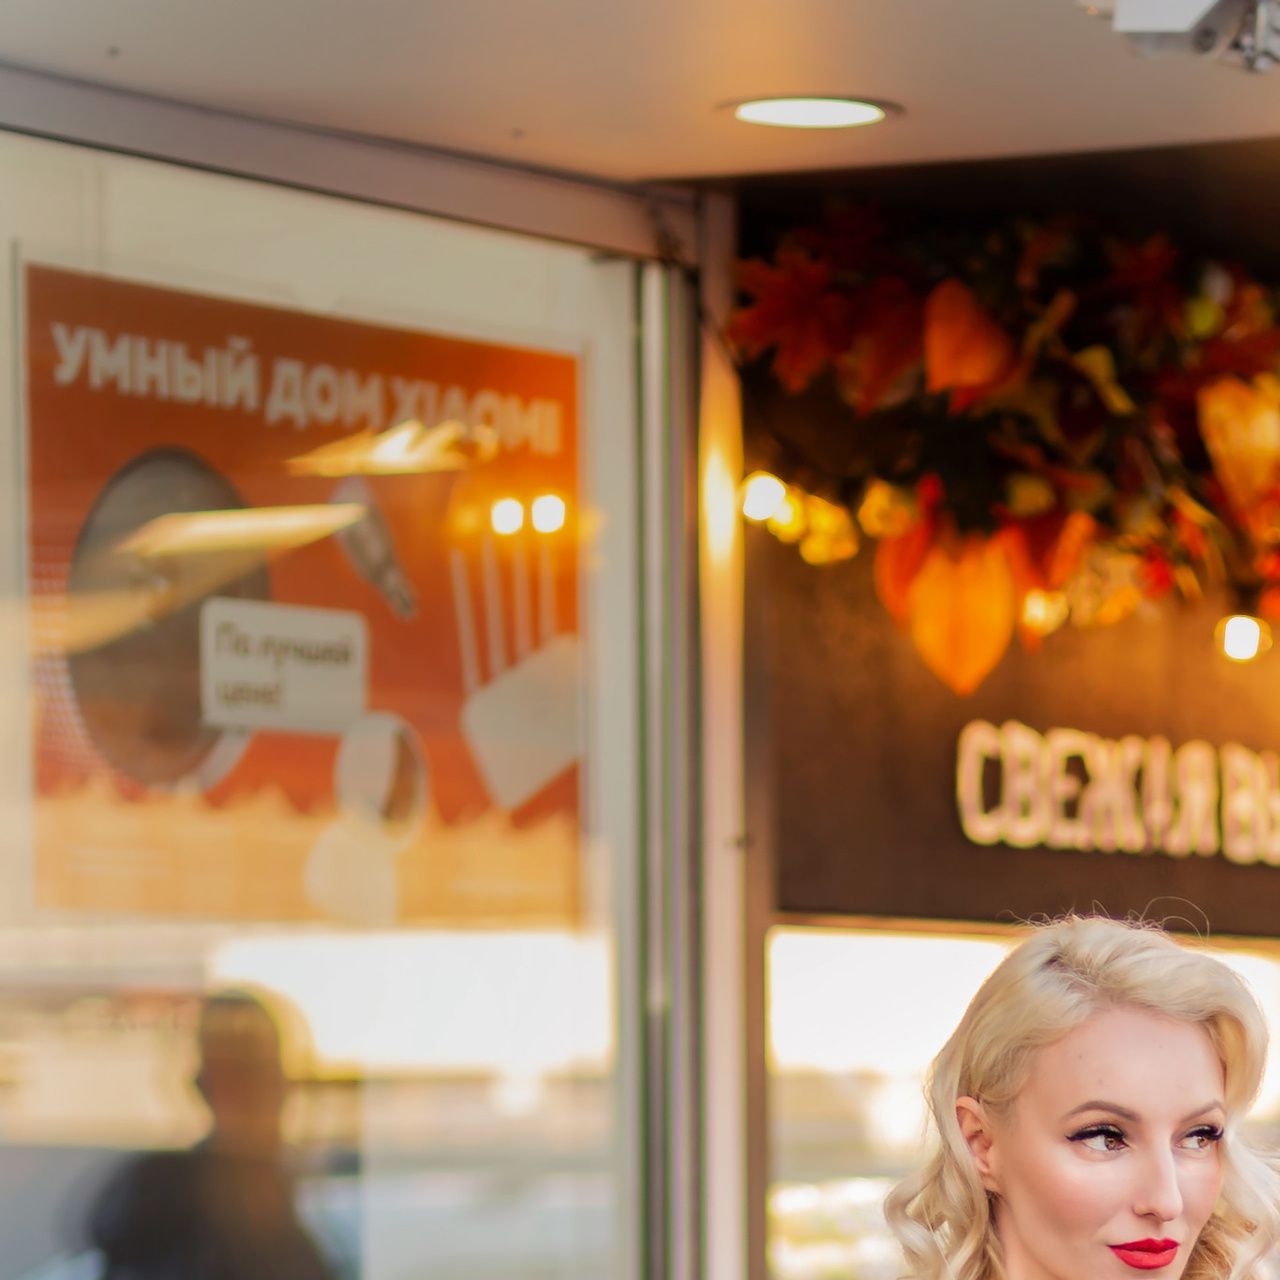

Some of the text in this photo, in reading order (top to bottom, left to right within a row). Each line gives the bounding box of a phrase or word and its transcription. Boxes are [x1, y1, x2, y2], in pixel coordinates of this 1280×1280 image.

[50, 321, 259, 410] УМНЫЙ
[265, 358, 383, 430] ДОМ
[956, 719, 1219, 858] СВЕЖАЯ
